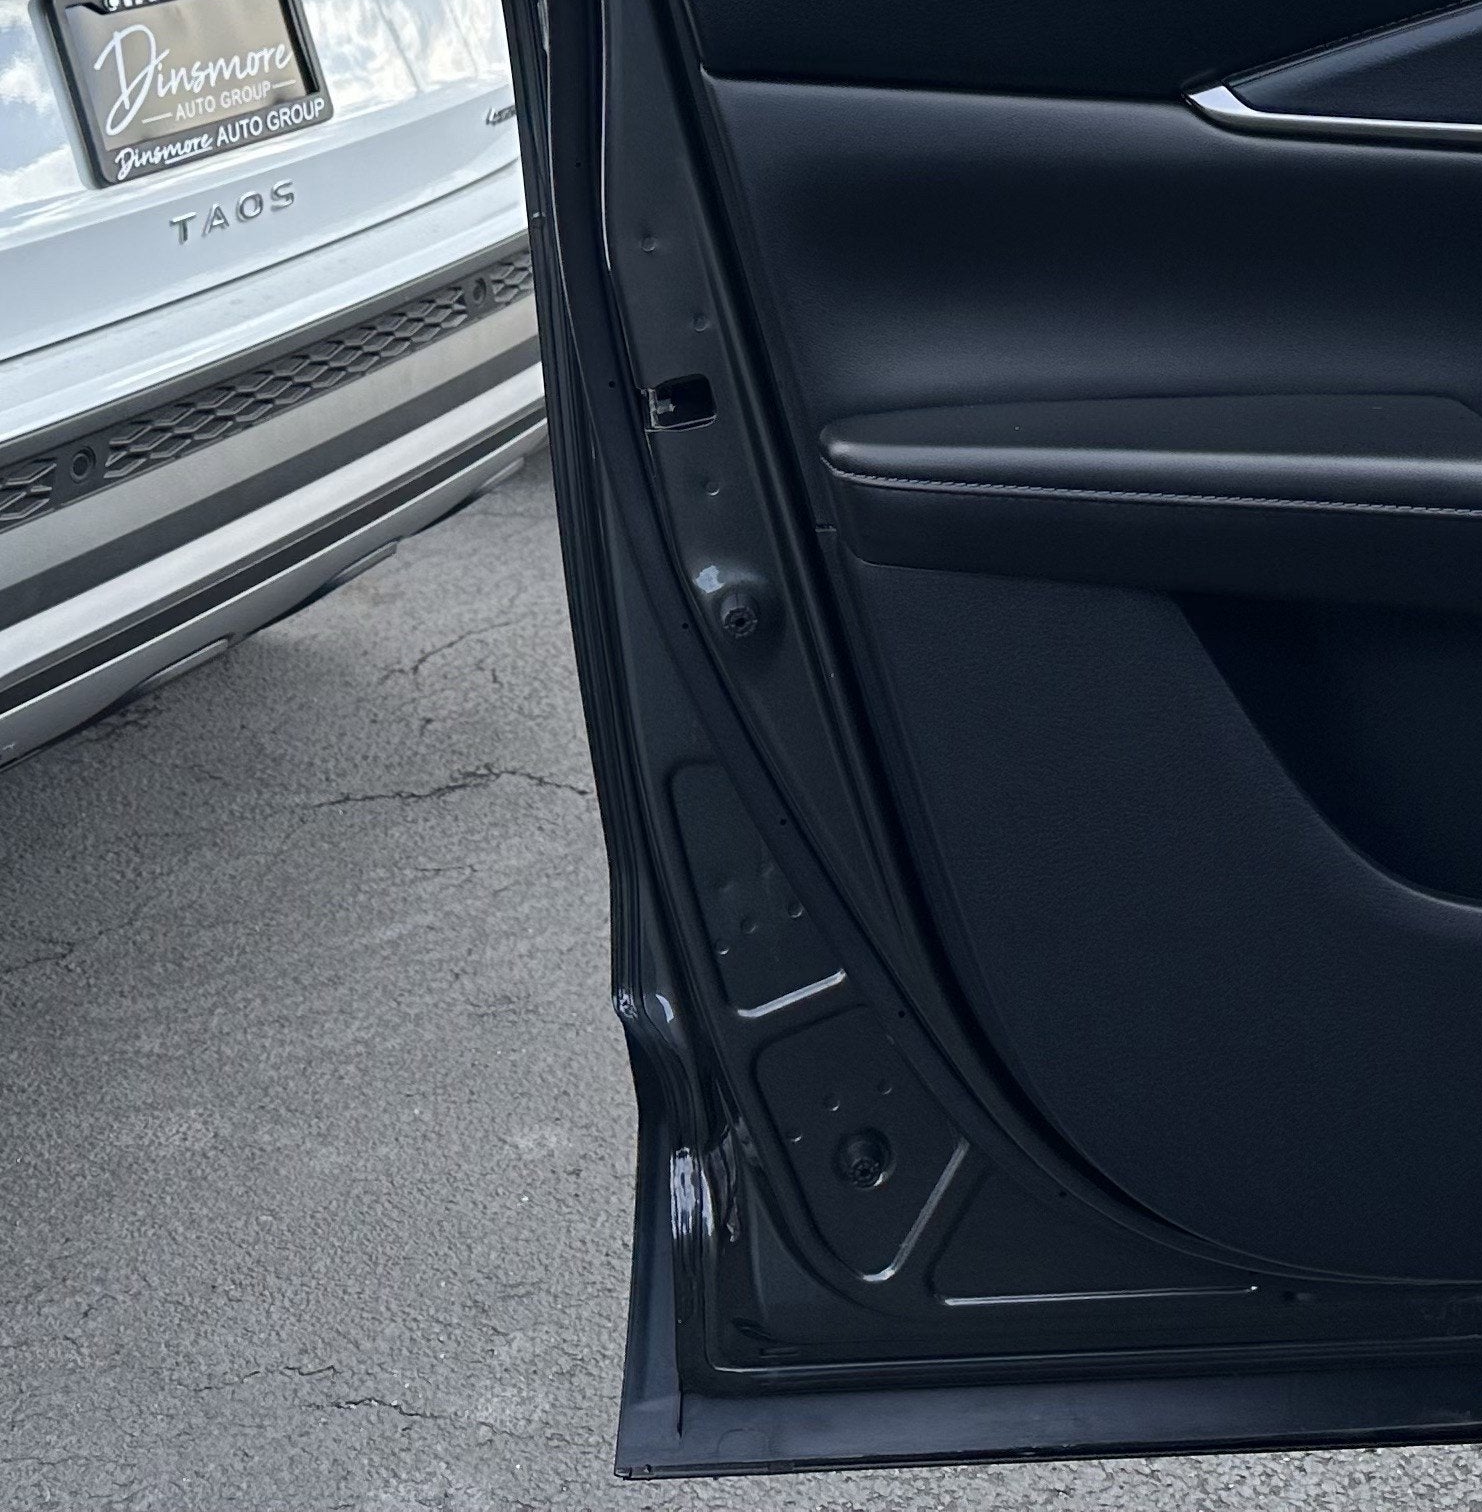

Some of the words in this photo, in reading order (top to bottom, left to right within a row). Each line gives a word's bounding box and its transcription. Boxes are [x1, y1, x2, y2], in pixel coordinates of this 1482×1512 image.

[94, 24, 293, 136] Dinsmore
[174, 96, 216, 121] AUTO
[220, 80, 273, 108] GROUP
[115, 133, 213, 181] Dinsmore
[216, 118, 263, 147] AUTO
[266, 97, 325, 132] GROUP
[169, 178, 295, 245] TAOS
